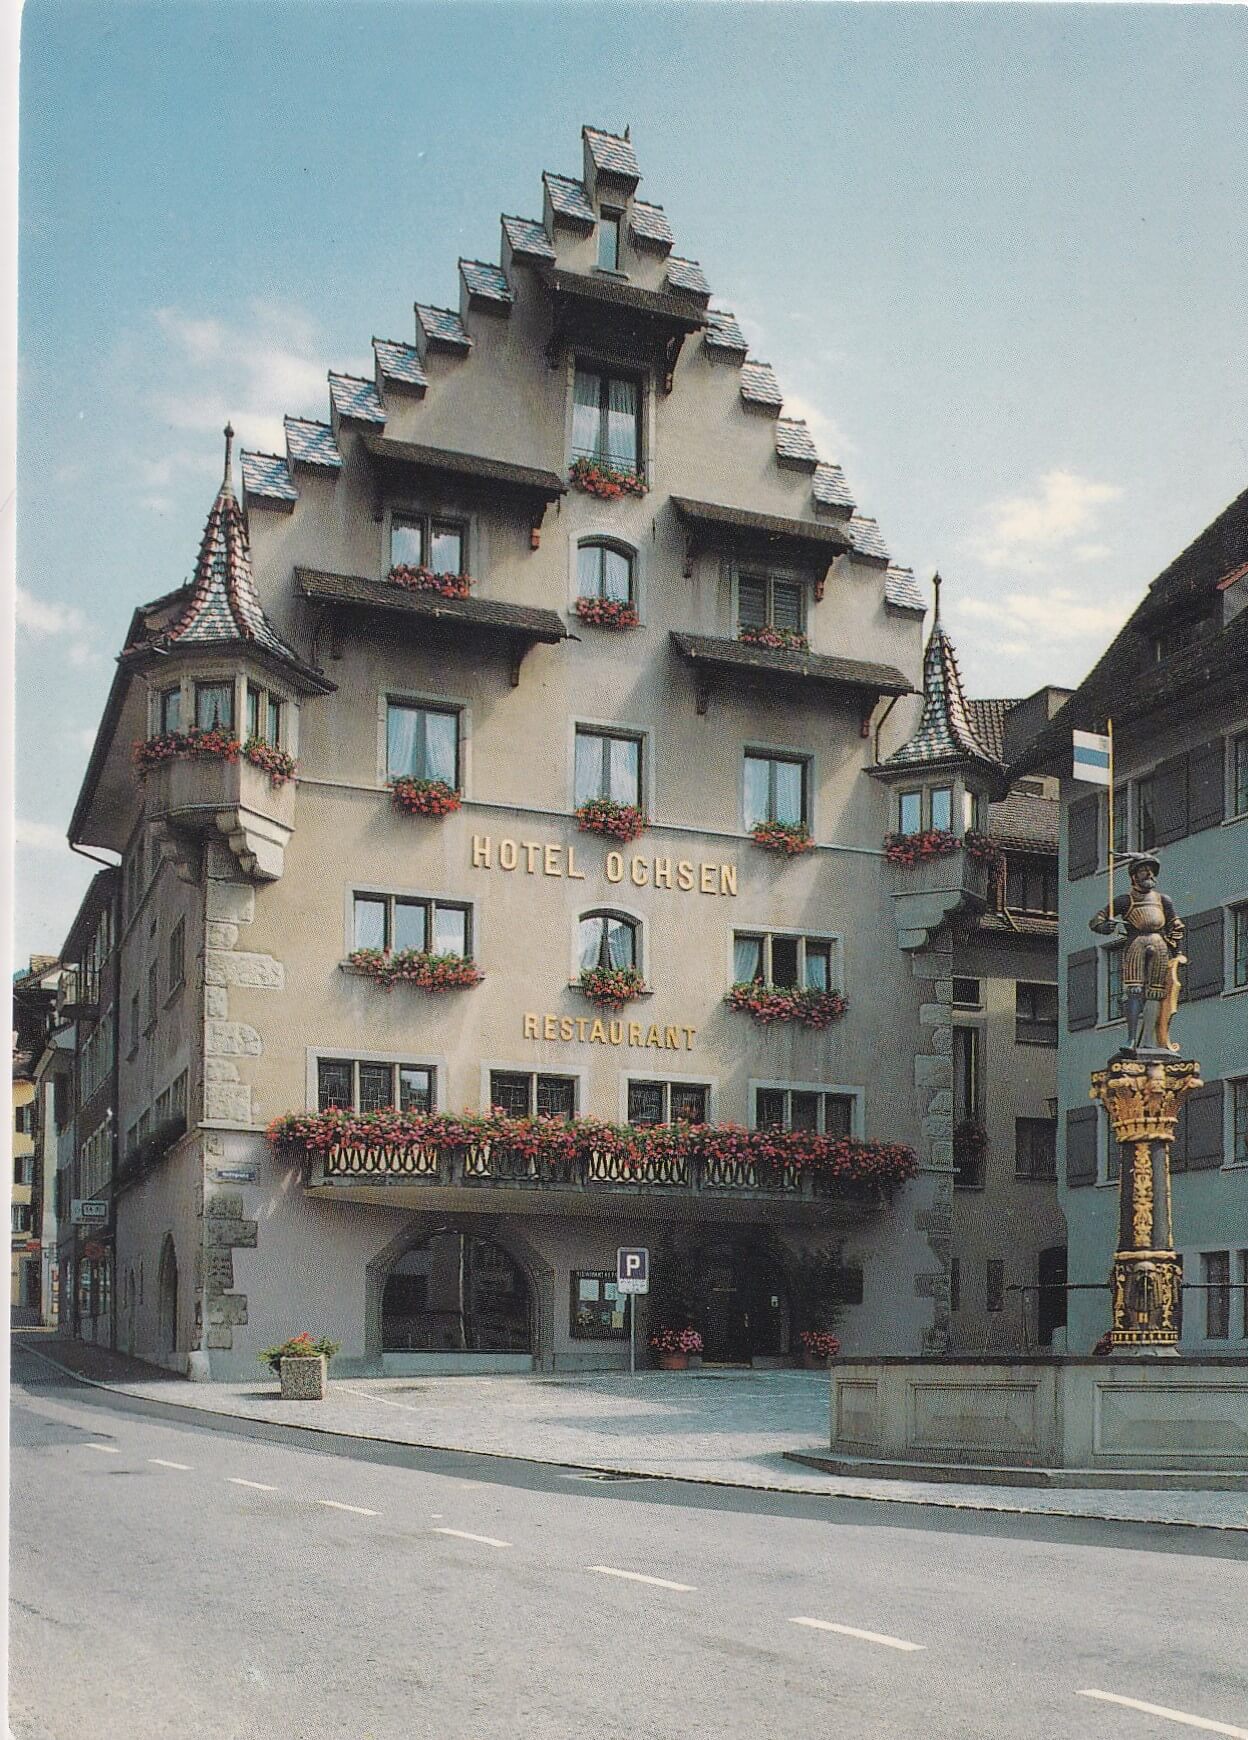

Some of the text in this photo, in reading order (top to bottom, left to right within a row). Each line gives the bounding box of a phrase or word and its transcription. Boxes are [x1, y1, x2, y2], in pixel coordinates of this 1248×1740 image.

[472, 834, 737, 896] HOTEL OCHSEN
[523, 1011, 696, 1050] RESTAURANT
[626, 1254, 640, 1276] P
